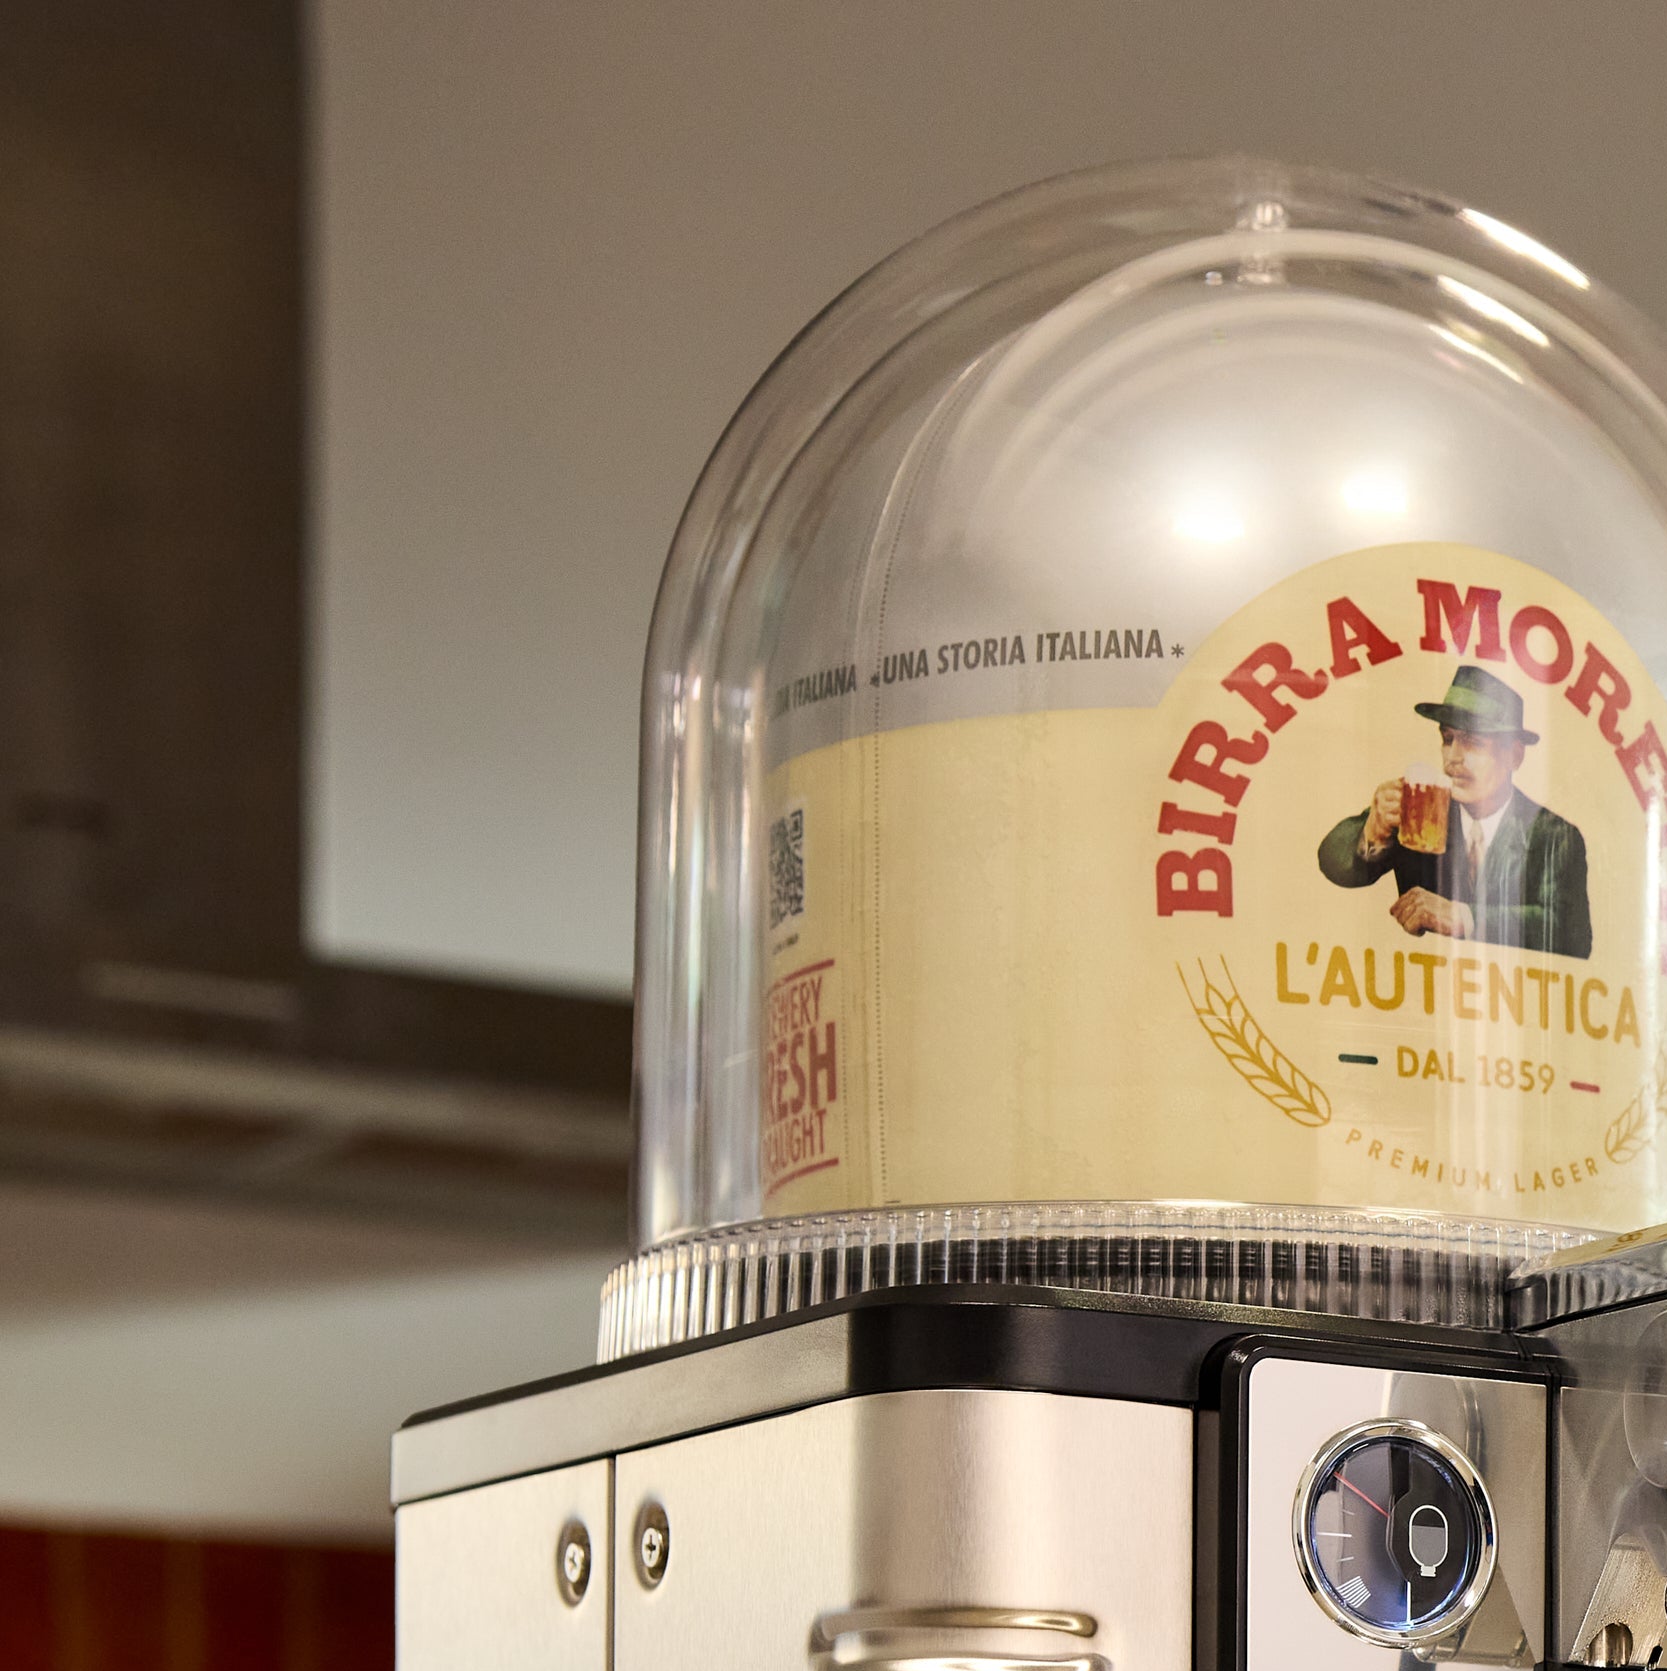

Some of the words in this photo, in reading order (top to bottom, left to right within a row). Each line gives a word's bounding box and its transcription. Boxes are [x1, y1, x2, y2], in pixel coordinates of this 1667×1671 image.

[883, 648, 929, 685] UNA
[936, 634, 1026, 675] STORIA
[1036, 628, 1164, 663] ITALIANA
[1156, 595, 1403, 918] BIRRA
[1274, 941, 1642, 1049] L'AUTENTICA
[1396, 1045, 1466, 1083] DAL
[1476, 1054, 1556, 1095] 1859
[1345, 1128, 1492, 1191] PREMIUM
[1514, 1156, 1599, 1193] LAGER
